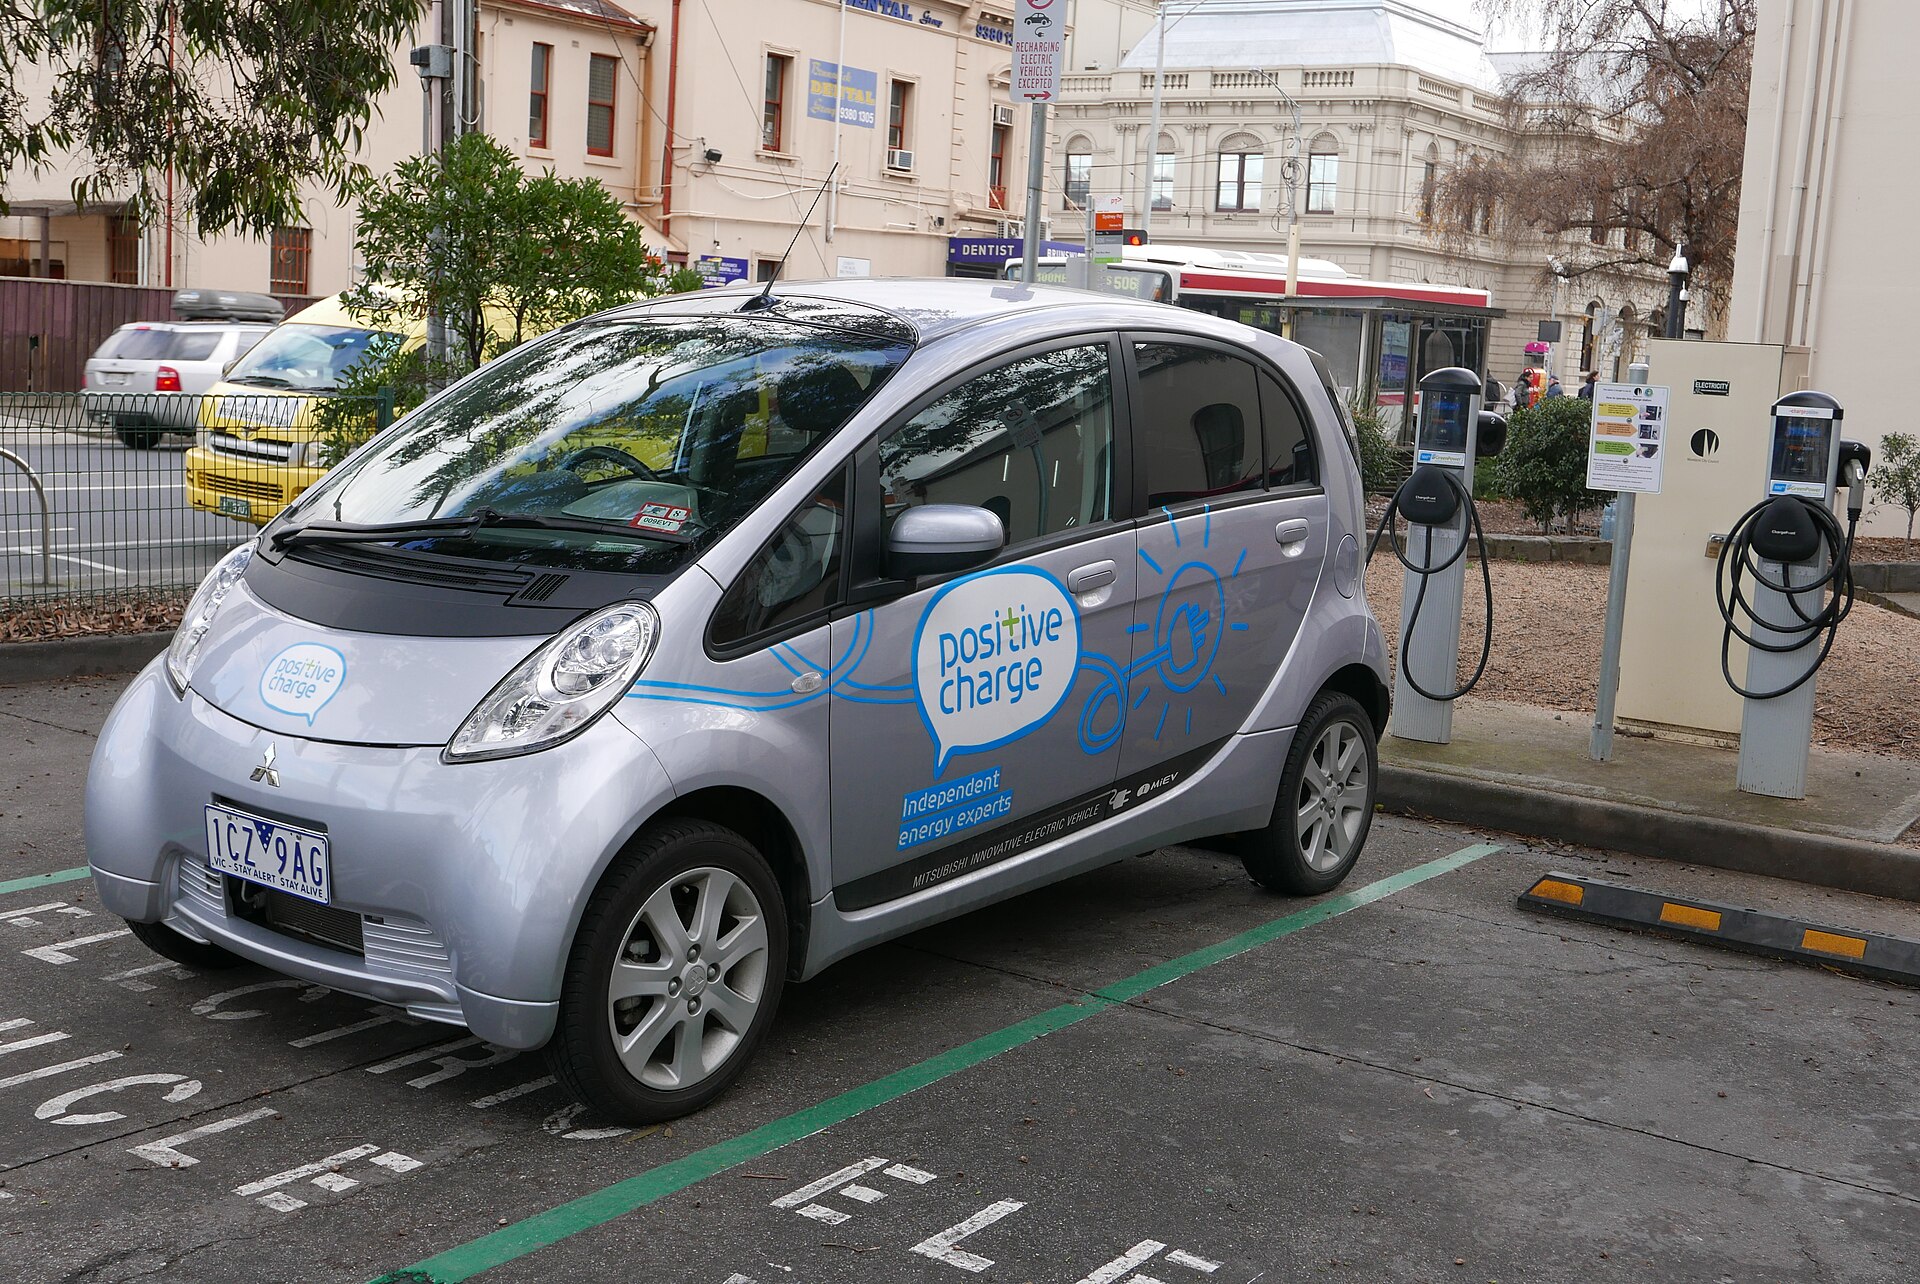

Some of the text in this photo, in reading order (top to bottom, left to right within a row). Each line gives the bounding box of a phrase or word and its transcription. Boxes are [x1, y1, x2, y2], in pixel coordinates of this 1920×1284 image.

[976, 24, 1003, 43] 9380
[1015, 41, 1060, 53] RECHARGING
[1020, 54, 1053, 65] ELECTRIC
[1019, 66, 1053, 77] VEHICLES
[1018, 78, 1052, 89] EXCEPTED
[858, 110, 875, 124] 1305
[961, 244, 1015, 256] DENTIST
[1114, 276, 1137, 291] 506
[1695, 381, 1729, 390] ELECTRICITY
[1490, 417, 1496, 425] 2
[1853, 444, 1859, 452] 2
[643, 517, 673, 527] 009EVT
[939, 604, 1062, 677] positive
[274, 658, 336, 683] positive
[268, 673, 316, 699] charge
[939, 657, 1042, 714] charge
[902, 769, 1000, 817] Independent
[898, 795, 1012, 846] energy experts
[912, 803, 1100, 888] MITSUBISHI INNOVATIVE ELECTRIC VEHICLE
[213, 856, 226, 868] VIC
[234, 863, 252, 875] STAY
[253, 869, 276, 883] ALERT
[280, 877, 299, 891] STAY
[300, 883, 323, 898] ALIVE
